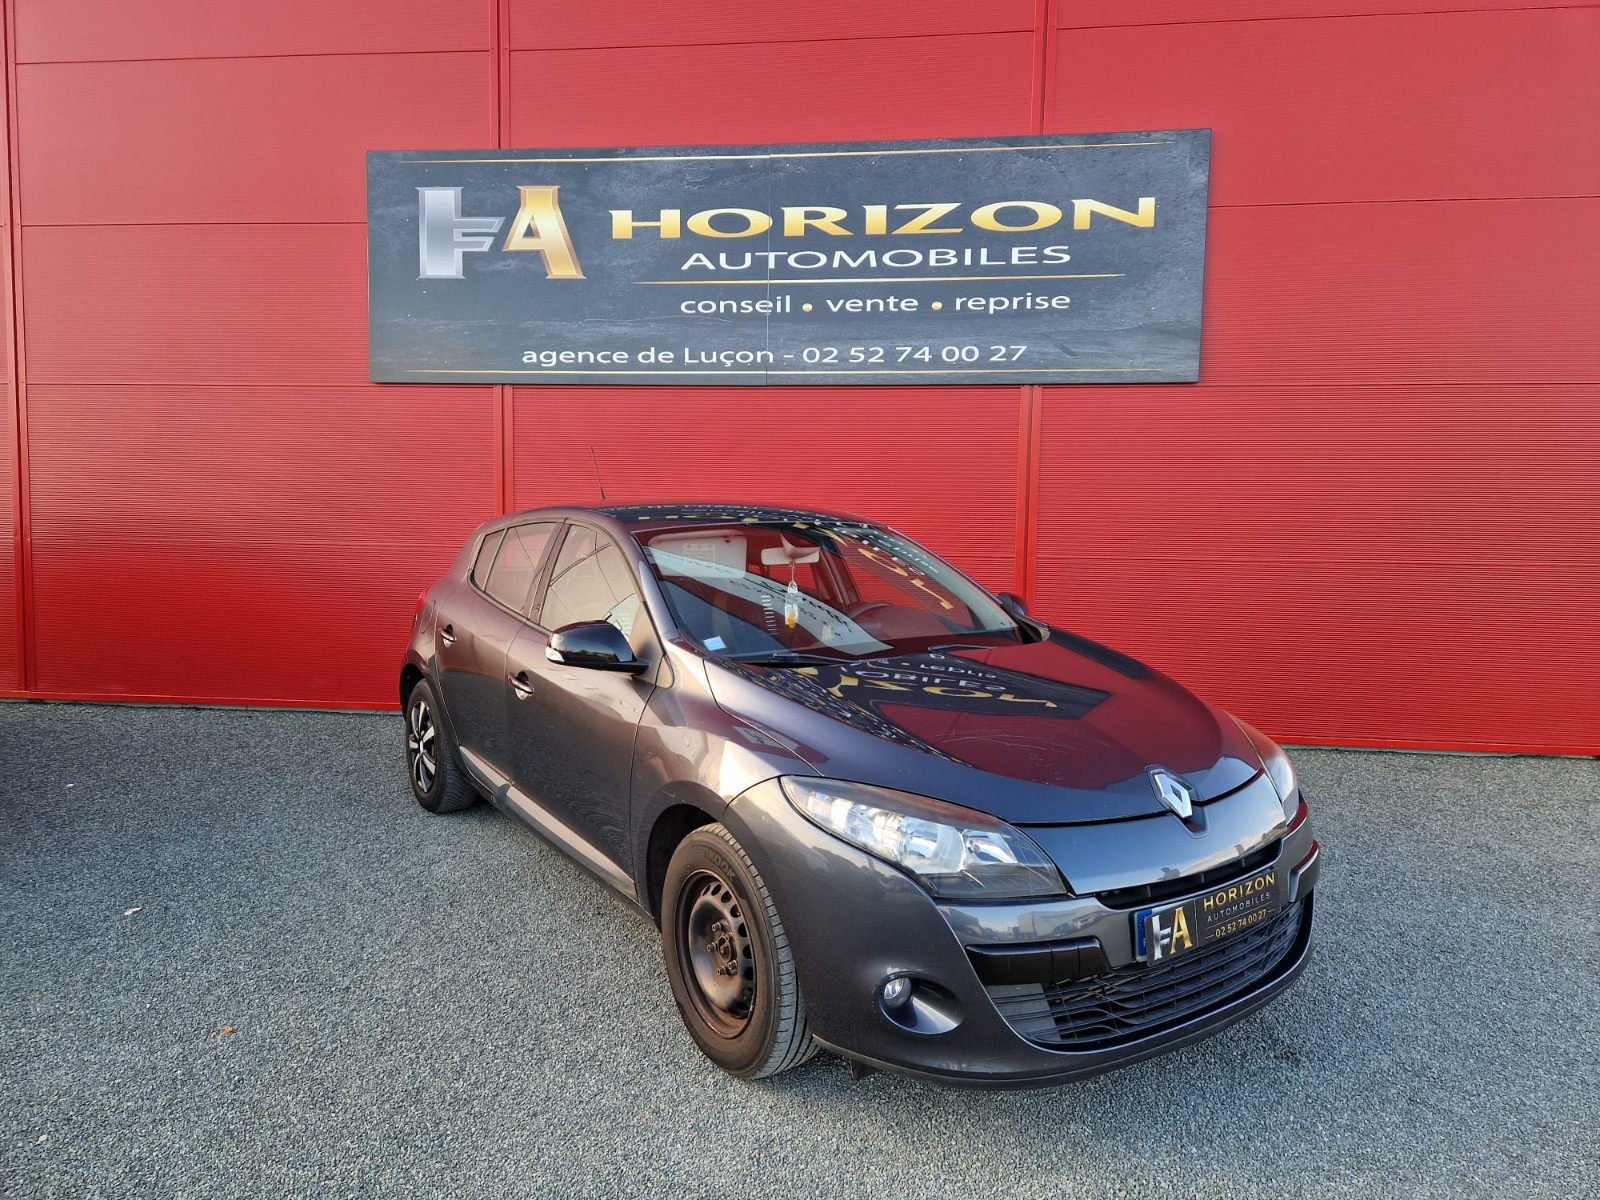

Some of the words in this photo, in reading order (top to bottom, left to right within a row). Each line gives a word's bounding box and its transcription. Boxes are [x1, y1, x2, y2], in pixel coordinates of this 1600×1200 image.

[608, 197, 1160, 240] HORIZON
[680, 245, 1071, 271] AUTOMOBILES
[680, 295, 791, 314] conseil
[826, 296, 919, 313] vente
[955, 293, 1071, 315] reprise
[522, 350, 629, 368] agence
[637, 346, 675, 364] de
[684, 347, 775, 368] Luçon
[802, 347, 841, 364] 02
[848, 346, 885, 364] 52
[891, 345, 933, 362] 74
[941, 345, 981, 362] 00
[989, 344, 1028, 362] 27
[1203, 872, 1276, 912] HORIZON
[1207, 891, 1271, 923] AUTOMOBILES
[1215, 926, 1226, 938] 02
[1227, 921, 1237, 933] 52
[1238, 917, 1247, 929] 74
[1248, 913, 1258, 924] 00
[1258, 909, 1267, 920] 27
